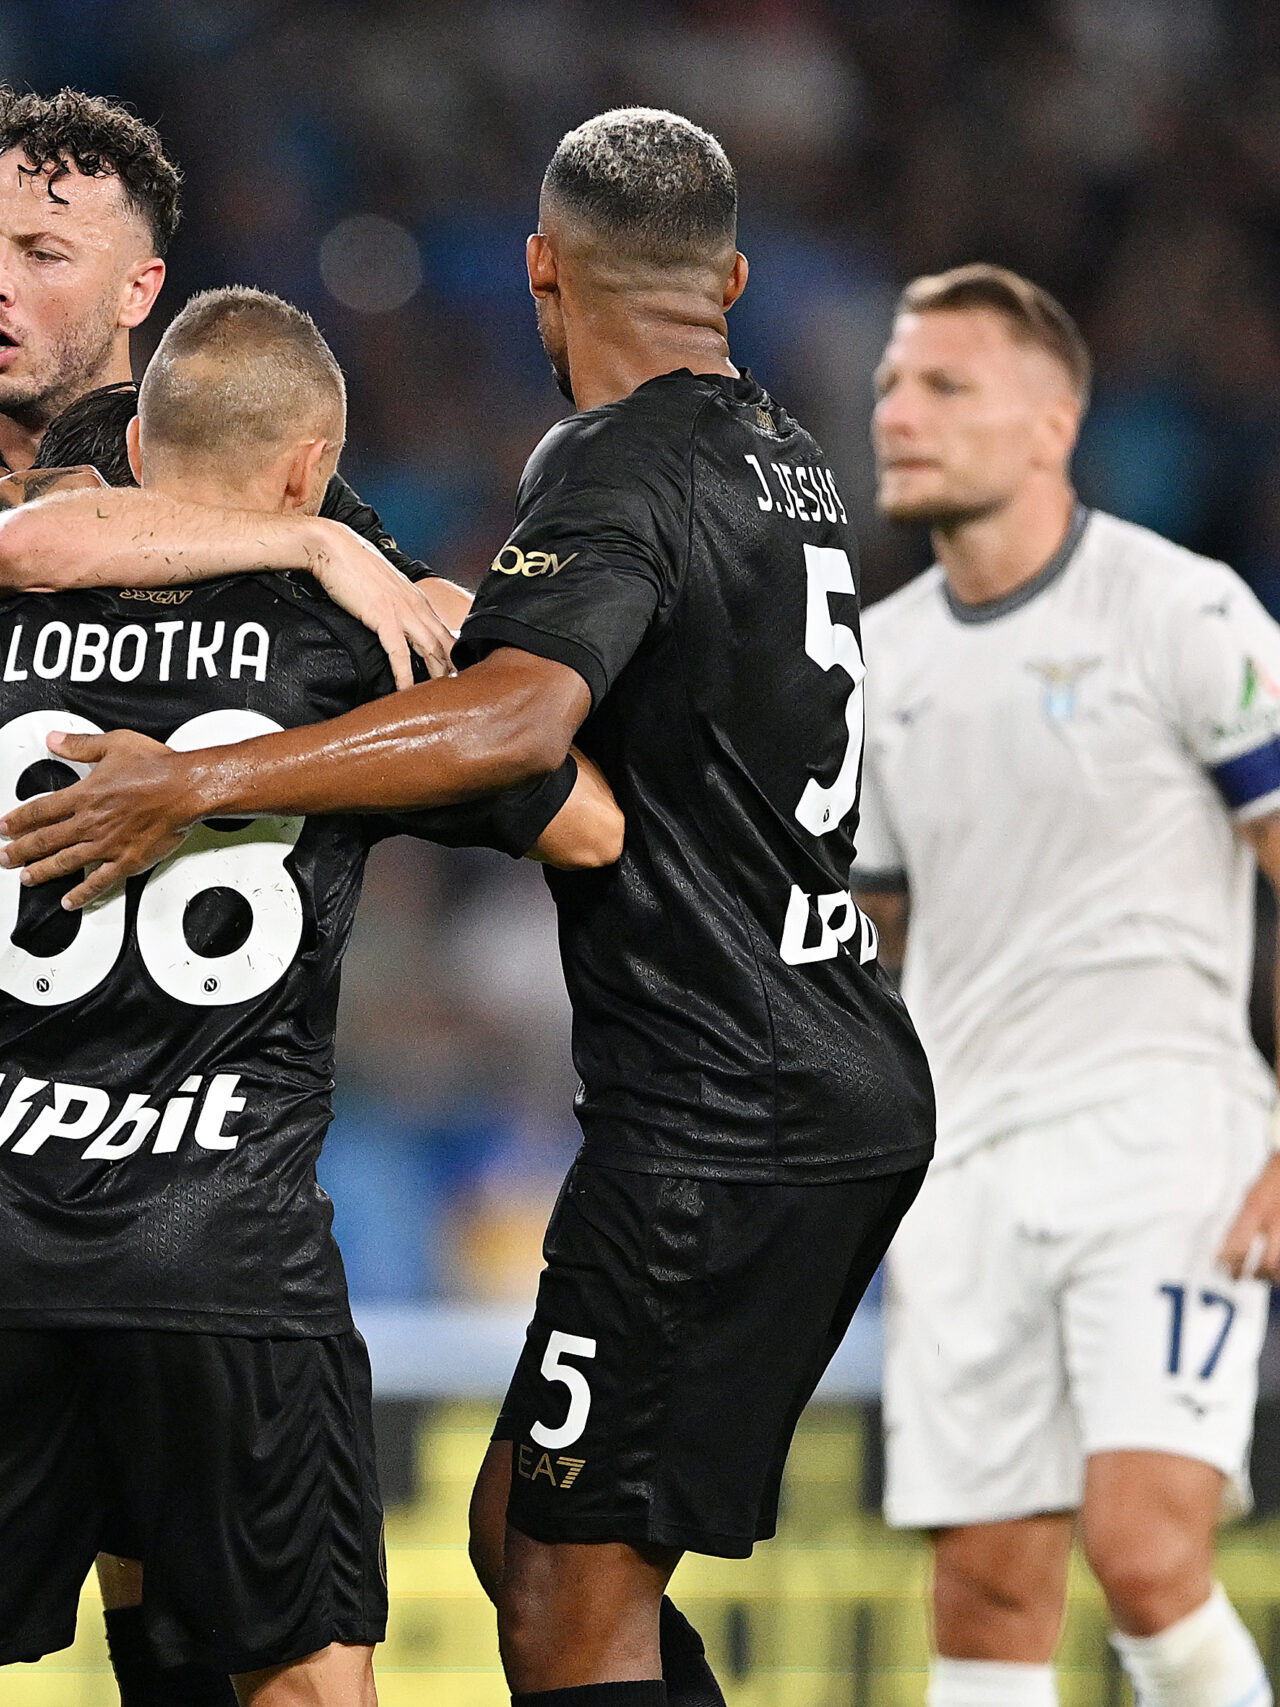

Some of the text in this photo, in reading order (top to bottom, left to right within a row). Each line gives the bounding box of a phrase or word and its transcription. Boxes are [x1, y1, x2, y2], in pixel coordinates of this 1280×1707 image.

[491, 545, 580, 578] bay
[2, 620, 270, 683] LOBOTKA
[794, 542, 868, 837] 5
[1159, 1284, 1237, 1380] 17
[529, 1330, 597, 1450] 5
[518, 1443, 587, 1489] EA7
